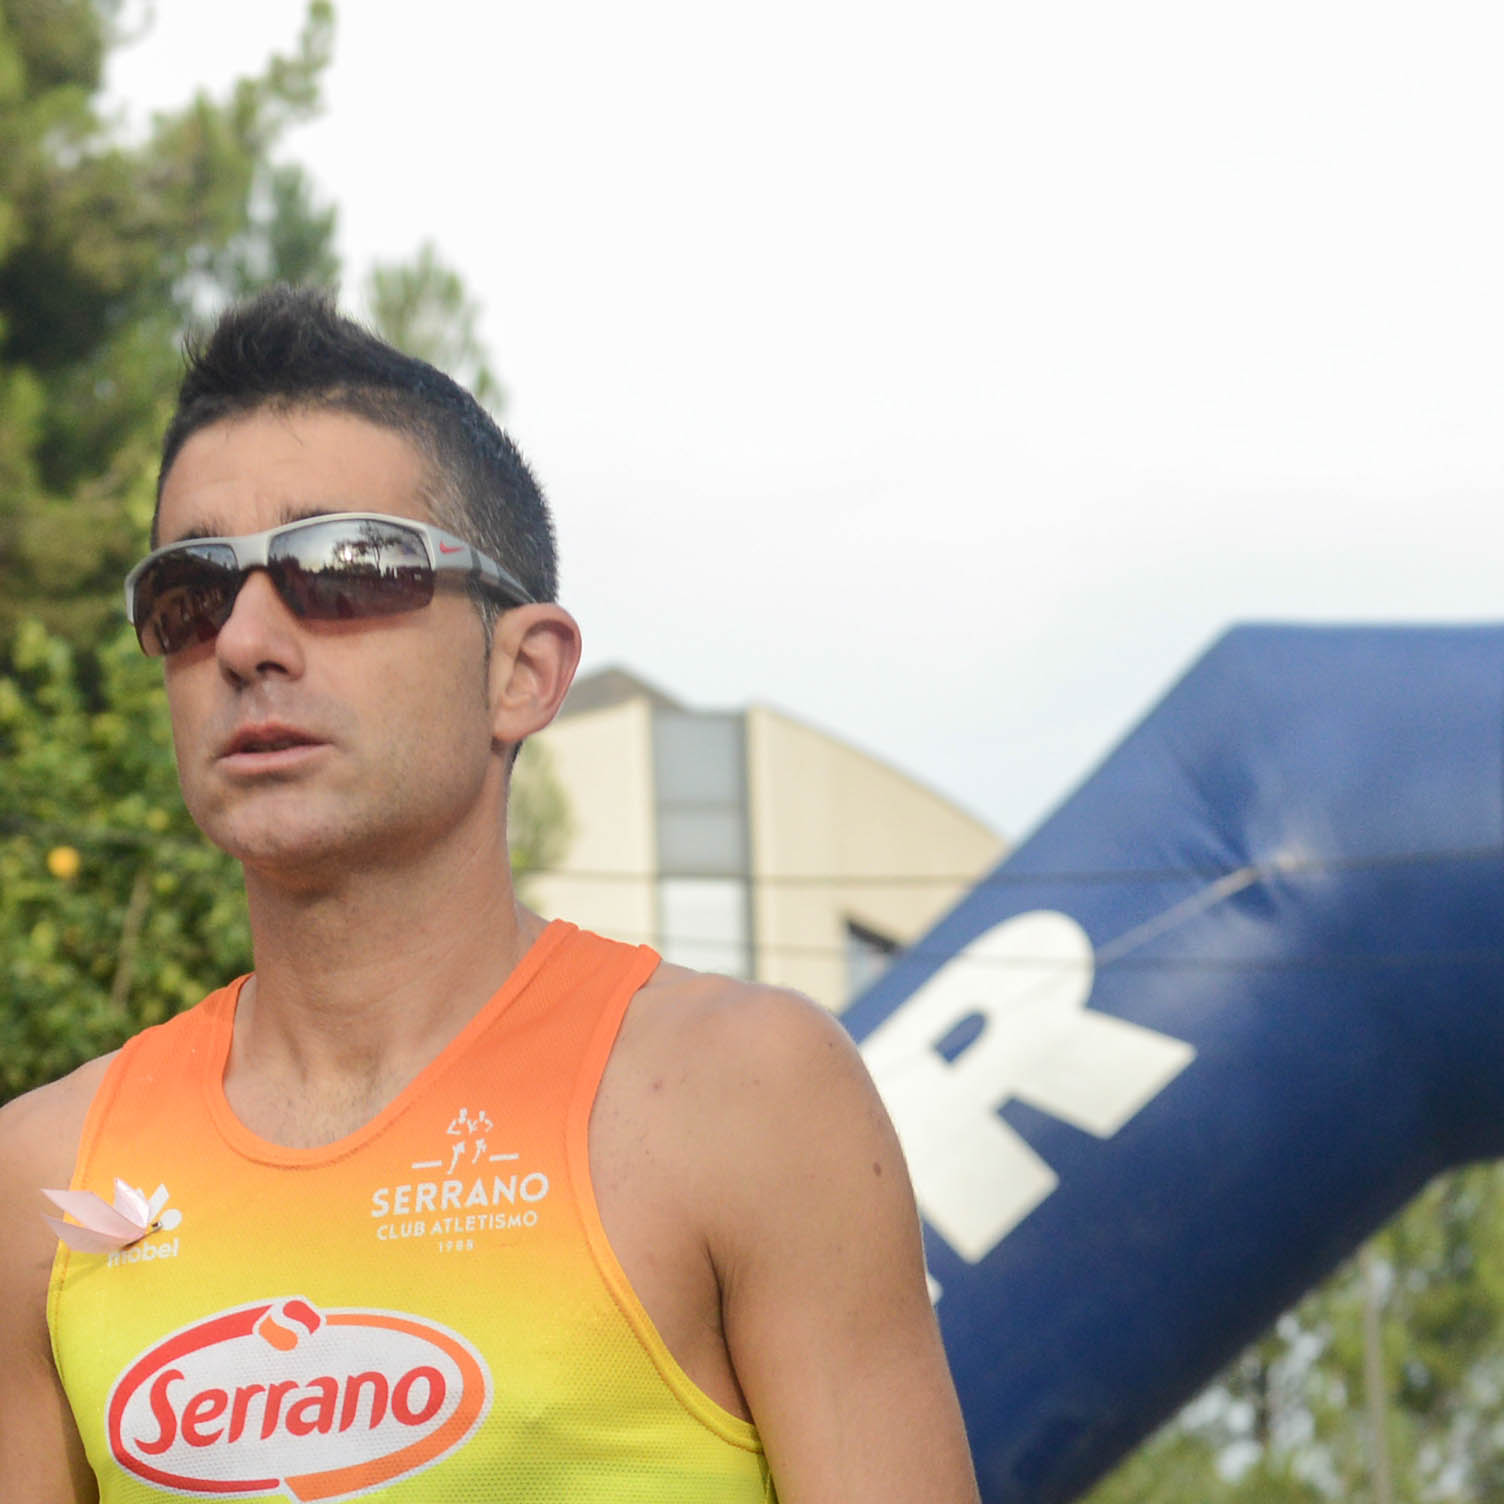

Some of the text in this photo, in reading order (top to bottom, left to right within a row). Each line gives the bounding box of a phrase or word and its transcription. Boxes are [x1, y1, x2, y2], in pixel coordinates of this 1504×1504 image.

[371, 1172, 549, 1218] SERRANO
[376, 1210, 539, 1241] CLUB ATLETISMO
[134, 1365, 446, 1455] Serrano
